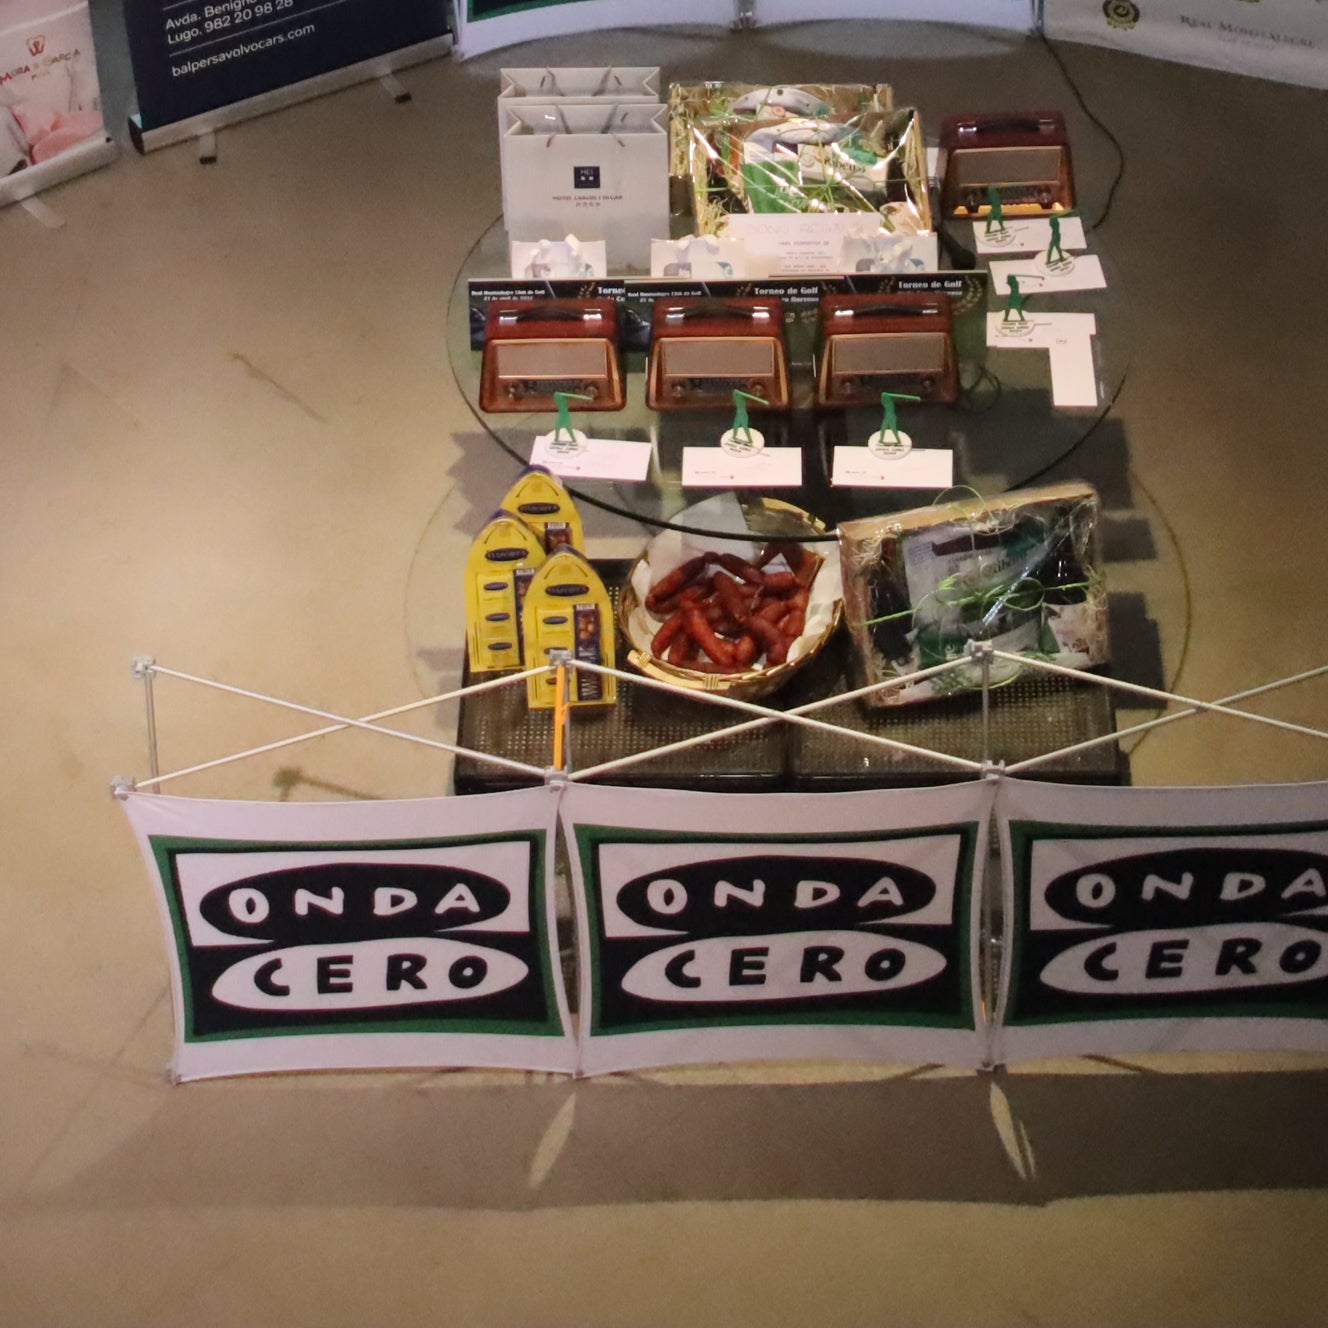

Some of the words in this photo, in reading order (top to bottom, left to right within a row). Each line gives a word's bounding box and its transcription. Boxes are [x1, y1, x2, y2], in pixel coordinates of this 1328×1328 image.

[164, 9, 200, 30] Avda.
[166, 25, 202, 47] Lugo.
[204, 14, 231, 32] 982
[233, 7, 252, 23] 20
[254, 1, 273, 16] 98
[171, 22, 316, 78] balpersavolvocars.com
[754, 287, 785, 295] Torneo
[787, 286, 798, 295] de
[800, 286, 819, 294] Golf
[898, 281, 929, 289] Torneo
[930, 280, 942, 288] de
[944, 280, 962, 288] Golf
[228, 882, 480, 924] ONDA
[647, 877, 903, 914] ONDA
[1076, 868, 1327, 908] ONDA
[254, 954, 488, 996] CERO
[664, 945, 906, 988] CERO
[1084, 938, 1321, 981] CERO
